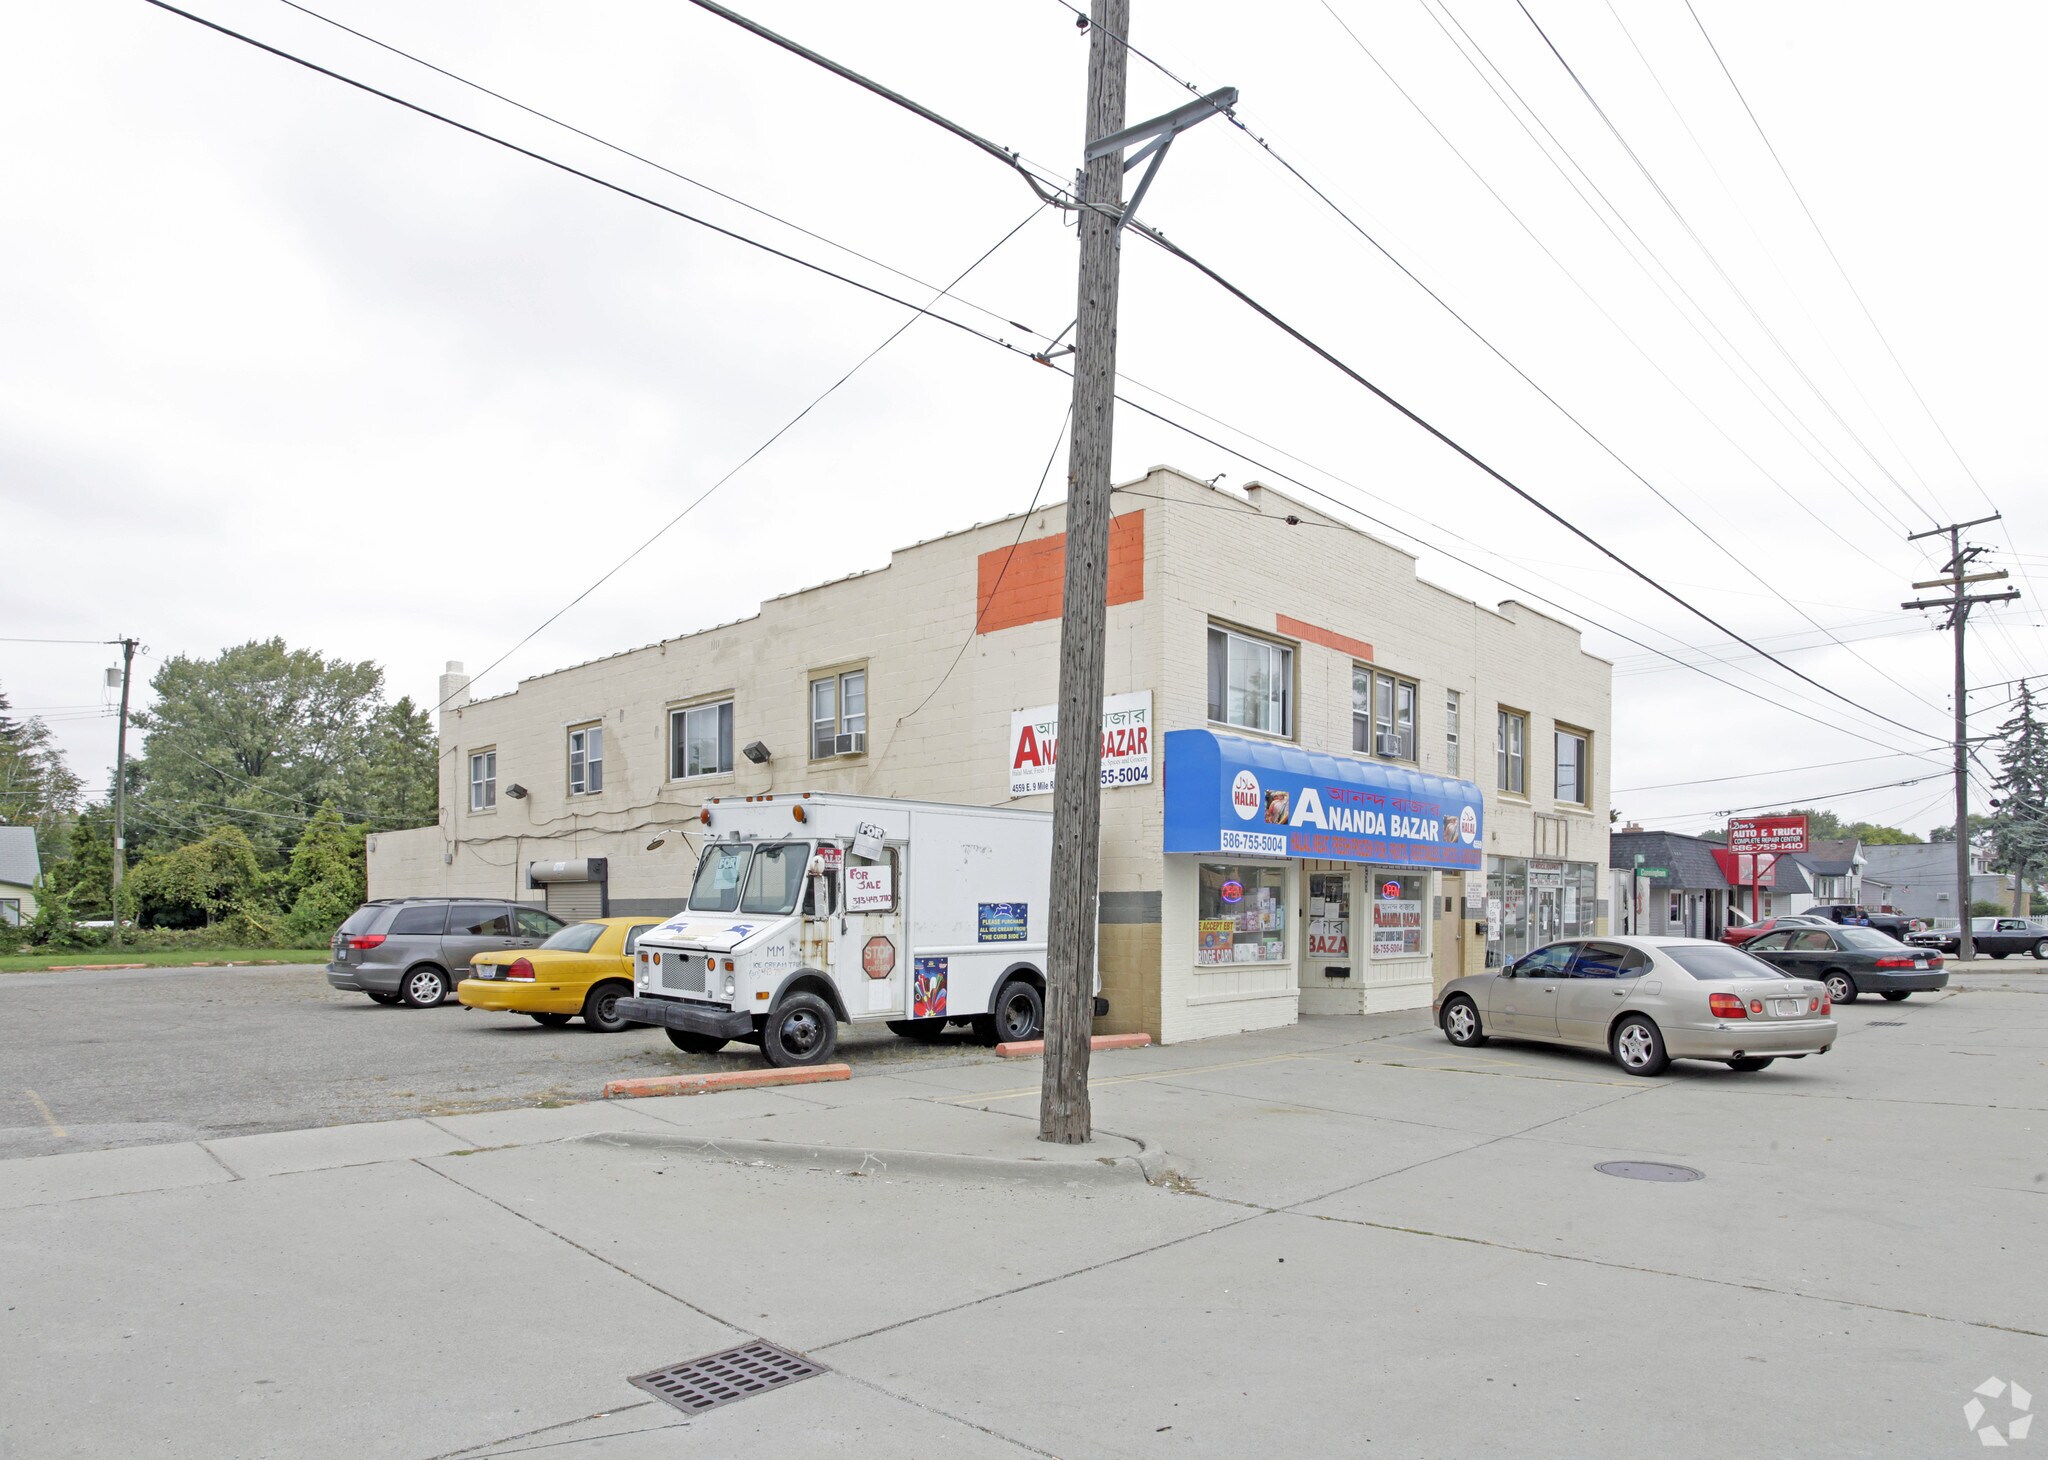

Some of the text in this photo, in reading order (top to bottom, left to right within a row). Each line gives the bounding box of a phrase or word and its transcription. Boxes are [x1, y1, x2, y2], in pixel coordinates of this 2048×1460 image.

[1012, 783, 1025, 793] 4559
[1033, 782, 1037, 791] 9
[1037, 781, 1049, 791] Mile
[1101, 766, 1148, 784] 55-5004
[1234, 791, 1258, 807] HALAL
[1391, 797, 1441, 816] বাজার
[1289, 787, 1439, 841] ANANDA BAZAR
[859, 821, 884, 840] FOR
[1461, 822, 1475, 834] HALAL
[1731, 821, 1755, 830] Don's
[1732, 827, 1803, 838] AUTO & TRUCK
[1223, 832, 1282, 852] 586-755-5004
[1734, 835, 1801, 845] COMPLETE REPAIR CENTER
[718, 857, 737, 870] FOR
[824, 854, 842, 863] ALE
[850, 868, 868, 880] FOR
[857, 881, 881, 890] SALE
[1222, 885, 1243, 898] OPEN
[1382, 884, 1400, 897] OPEN
[1202, 921, 1223, 931] ACCEPT
[1223, 921, 1234, 931] EBT
[1309, 935, 1349, 953] BAZA
